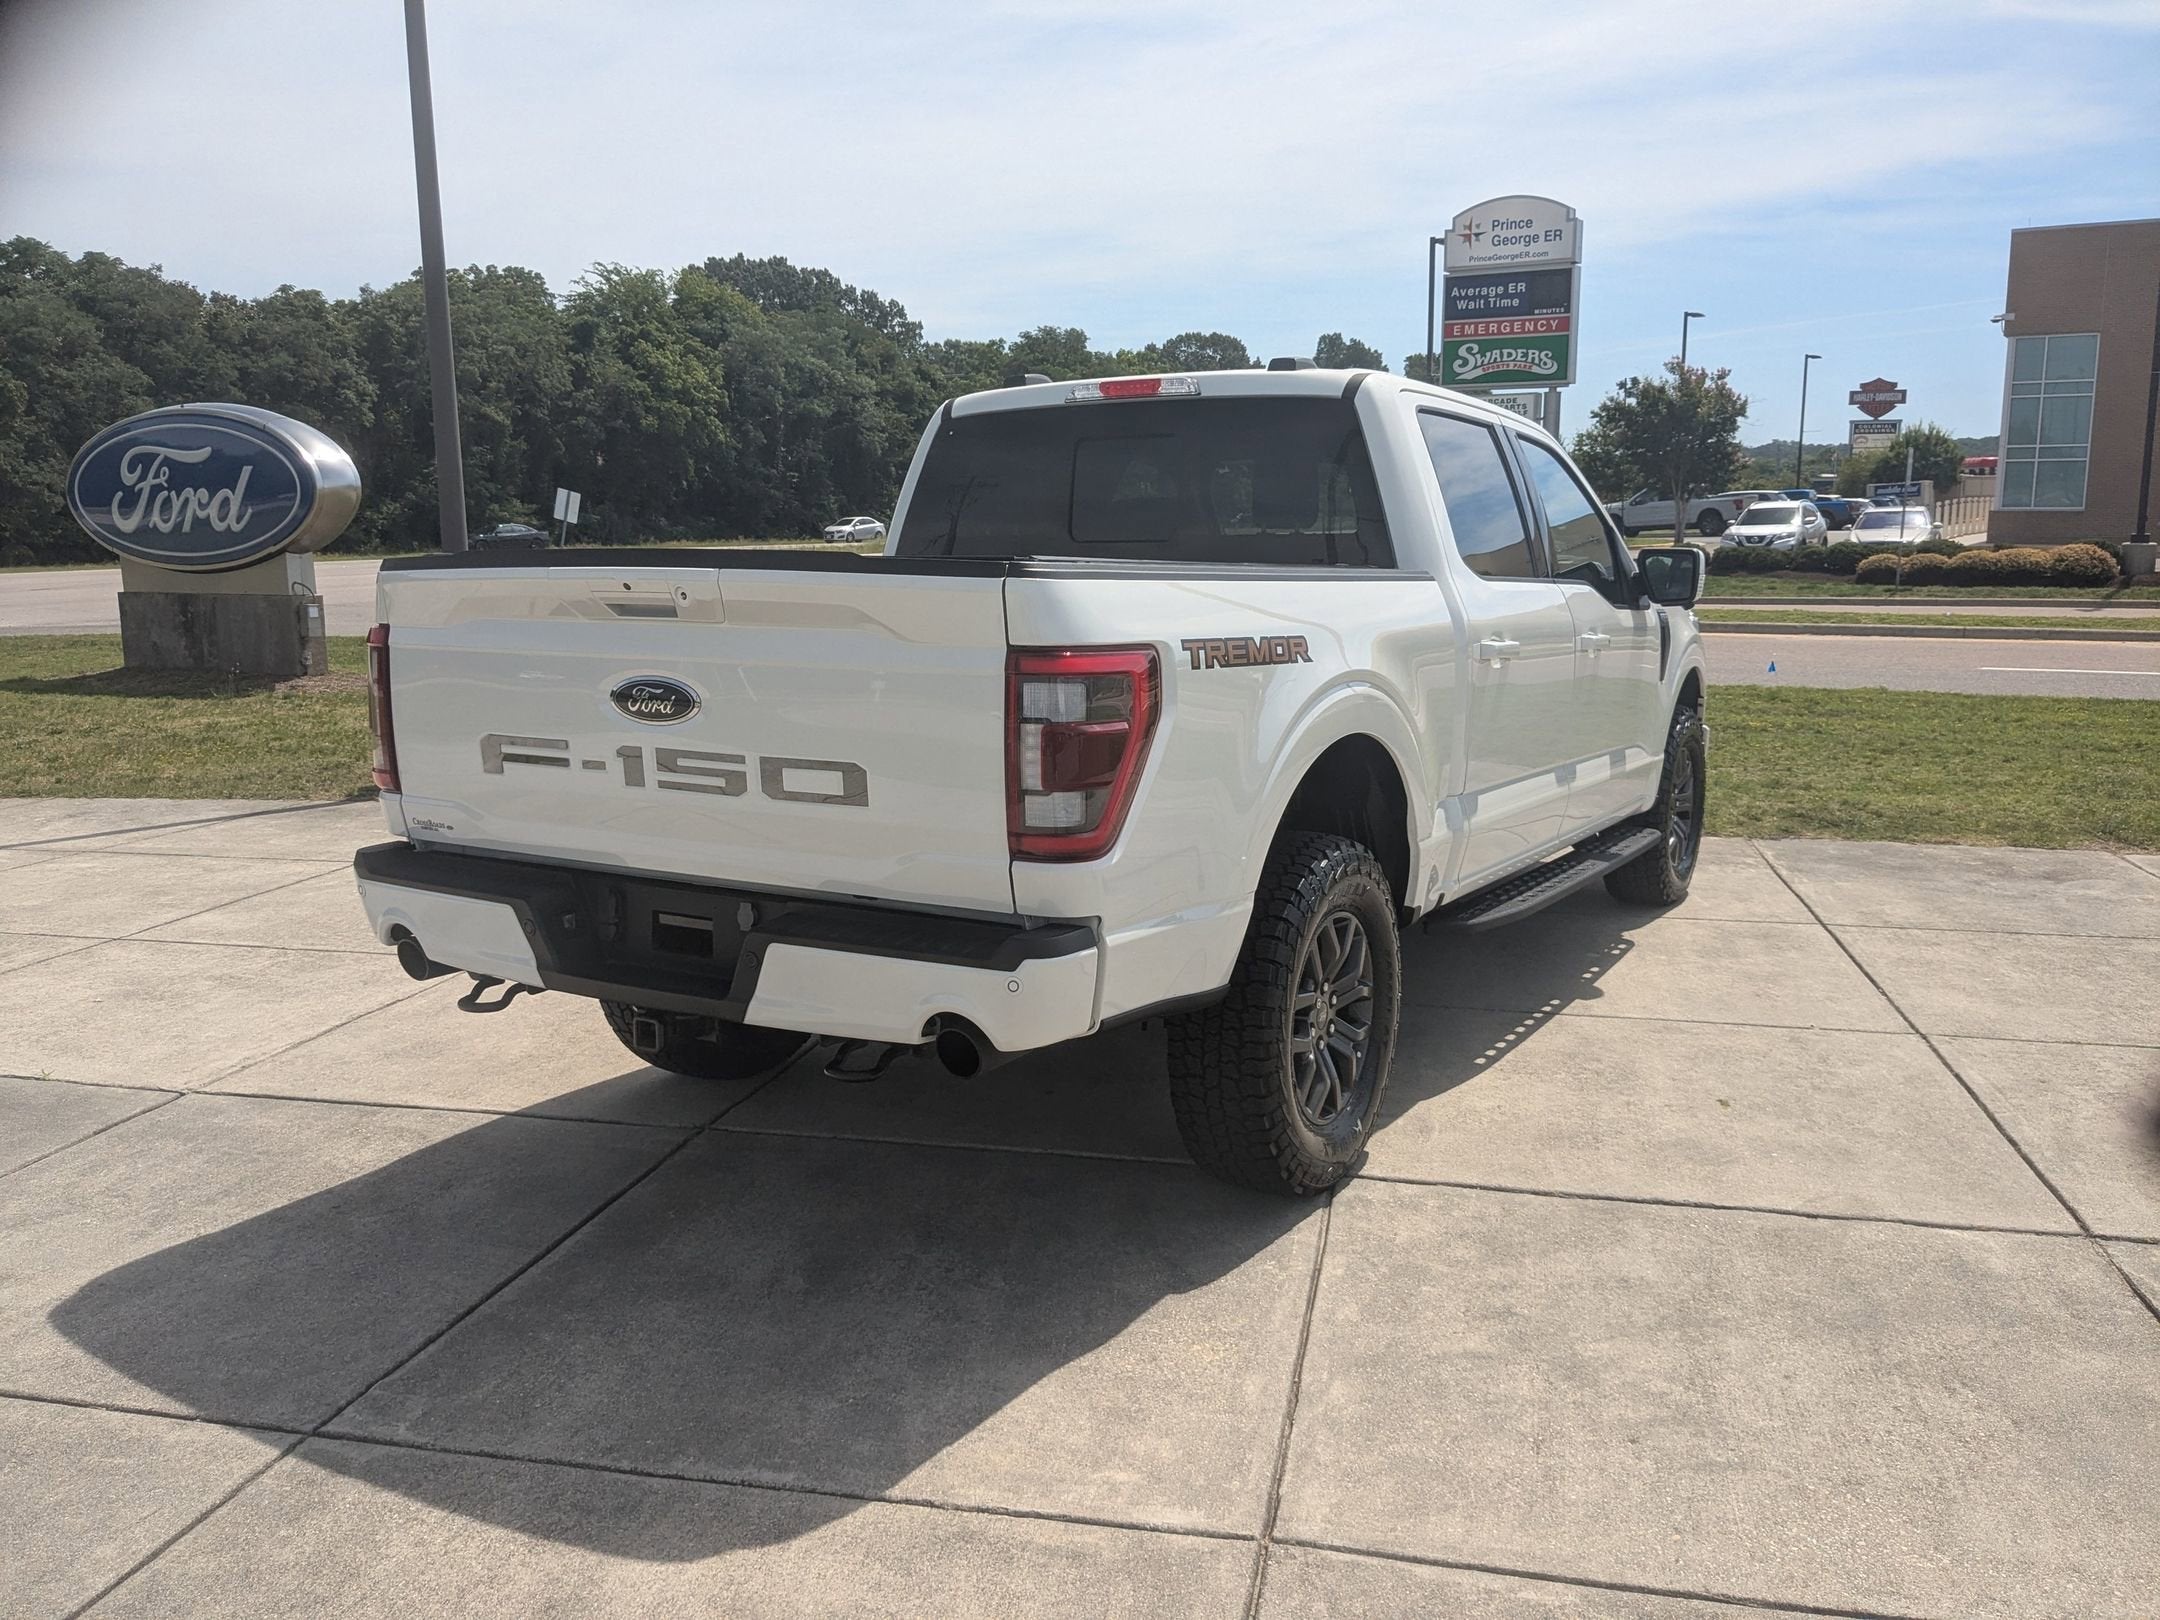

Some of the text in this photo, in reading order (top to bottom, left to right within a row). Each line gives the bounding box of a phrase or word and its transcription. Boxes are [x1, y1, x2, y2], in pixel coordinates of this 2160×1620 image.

[1492, 218, 1533, 231] Prince
[1491, 229, 1563, 247] George ER
[1469, 251, 1549, 263] PrinceGeorgeER.com
[1451, 282, 1526, 297] Average ER
[1456, 298, 1520, 310] Wait Time
[1453, 319, 1559, 336] EMERGENCY
[1482, 363, 1510, 372] SPORTS
[1483, 397, 1518, 406] RCADE
[111, 445, 253, 534] Ford
[1180, 635, 1313, 670] TREMOR
[628, 686, 676, 714] Ford
[480, 733, 869, 808] F-150
